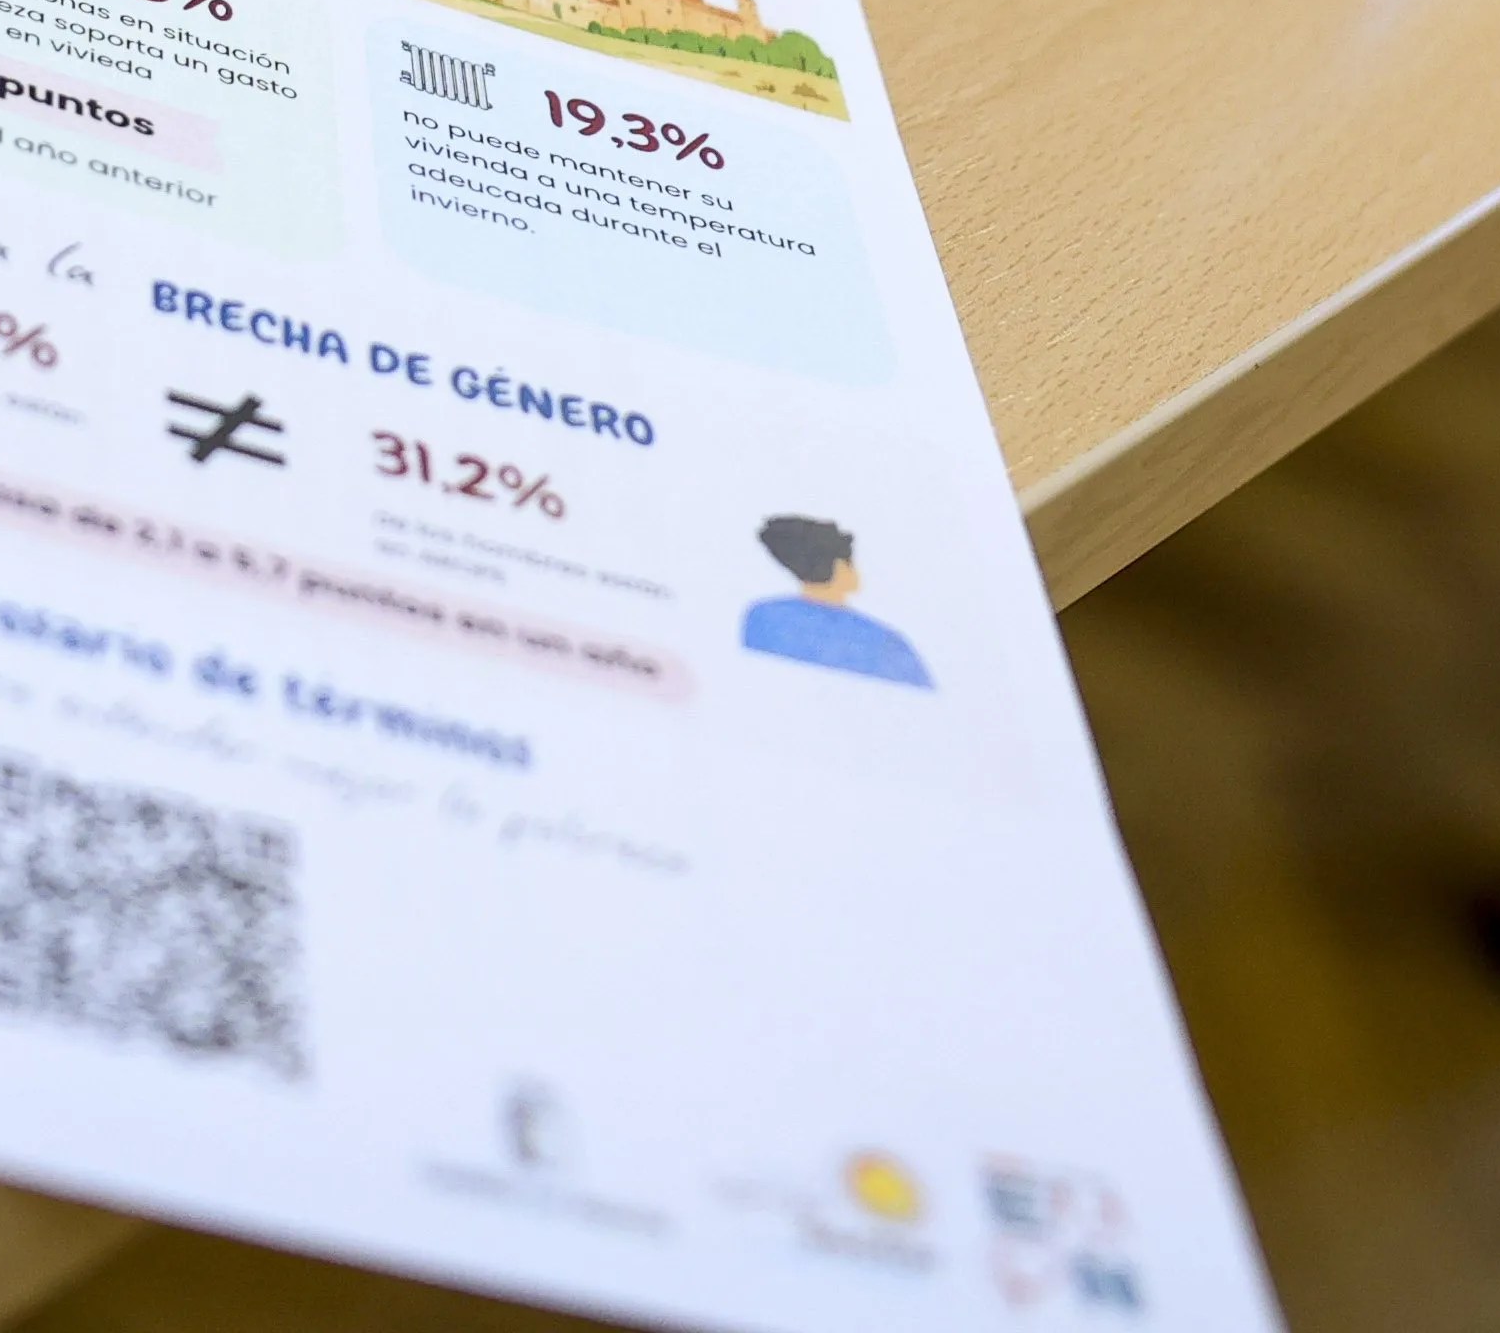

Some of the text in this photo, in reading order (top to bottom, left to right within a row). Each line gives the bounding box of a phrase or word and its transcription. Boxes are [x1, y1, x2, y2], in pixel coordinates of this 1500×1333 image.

[5, 27, 41, 47] en
[50, 39, 153, 81] vivieda
[54, 17, 164, 60] soporta
[173, 53, 208, 74] un
[217, 67, 298, 100] gasto
[119, 14, 154, 34] en
[163, 27, 290, 76] situación
[403, 110, 734, 212] no puede mantener su
[543, 89, 725, 170] 19,3%
[13, 136, 78, 166] año
[87, 158, 217, 207] anterior
[404, 135, 816, 257] vivienda a una temperatura
[407, 163, 722, 258] adeucada durante el
[410, 184, 535, 234] invierno.
[45, 241, 96, 288] la
[151, 280, 349, 365] BRECHA
[368, 342, 433, 386] DE
[450, 366, 655, 447] GÉNERO
